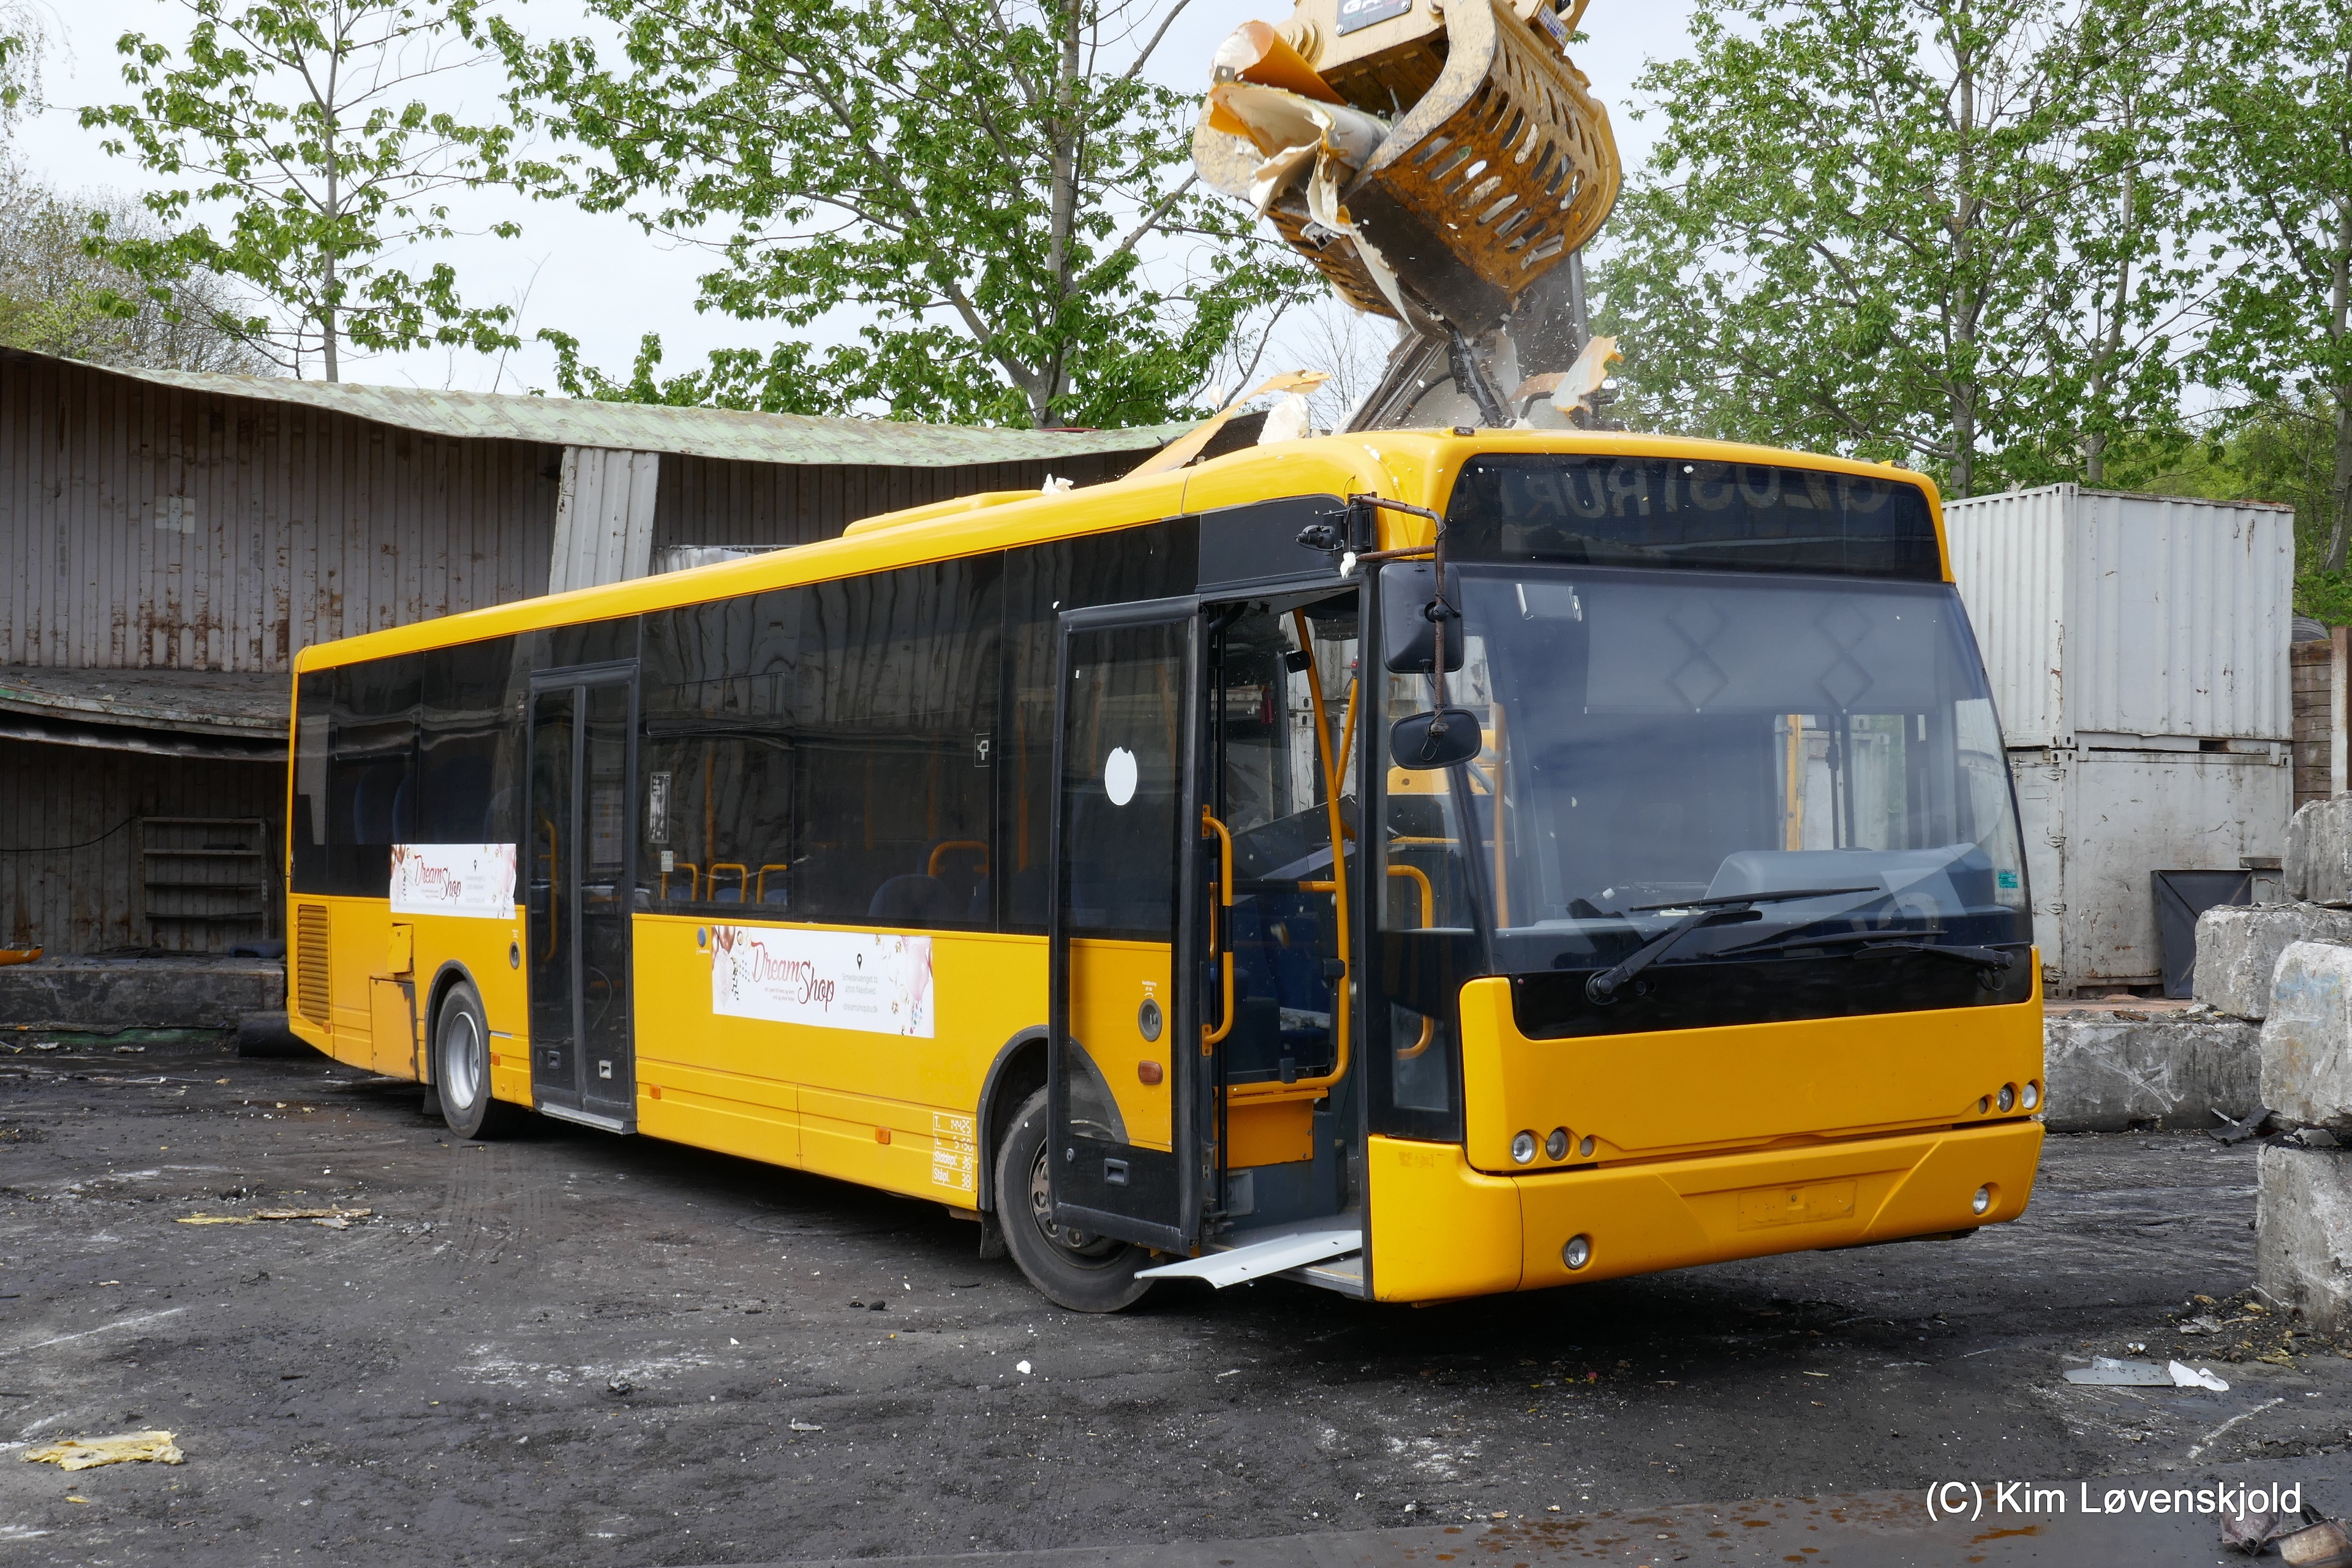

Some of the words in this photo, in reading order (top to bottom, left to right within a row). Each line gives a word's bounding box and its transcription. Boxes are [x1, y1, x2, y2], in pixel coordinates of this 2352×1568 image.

[415, 855, 442, 886] Dream
[440, 867, 461, 905] Shop
[751, 941, 800, 982] Dream
[798, 960, 834, 1012] Shop
[856, 986, 875, 994] Næstved
[935, 1116, 940, 1128] T.
[934, 1151, 957, 1168] Siddepl.
[962, 1156, 971, 1170] 36
[934, 1167, 950, 1184] Ståpl.
[962, 1174, 971, 1188] 38
